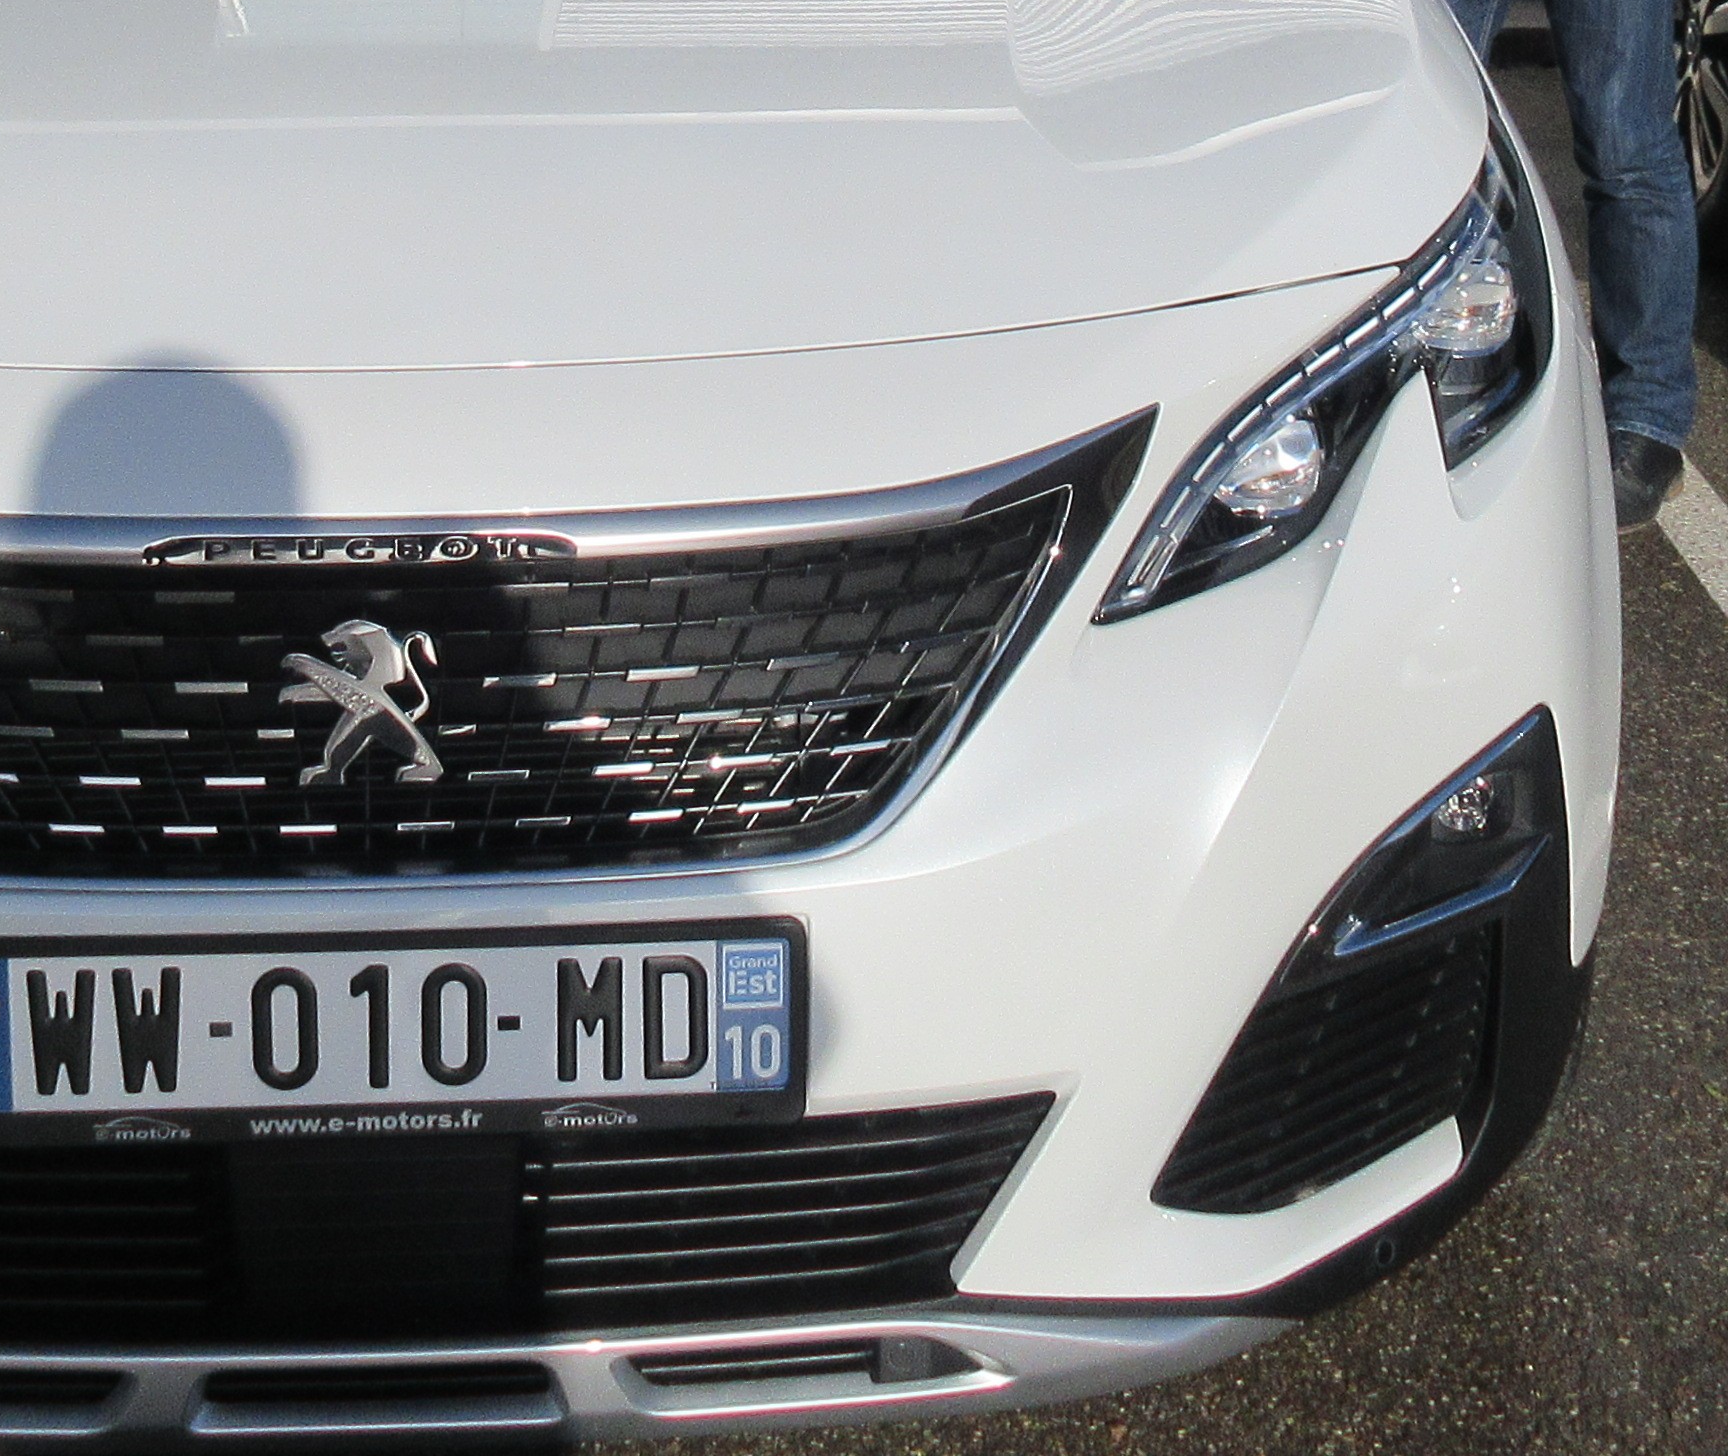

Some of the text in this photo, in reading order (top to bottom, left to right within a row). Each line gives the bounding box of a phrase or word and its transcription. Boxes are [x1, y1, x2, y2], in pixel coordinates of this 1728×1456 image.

[201, 536, 519, 561] PEUGEOT
[729, 955, 778, 968] Grand
[728, 969, 778, 994] Est
[26, 955, 710, 1095] WW-010-MD
[724, 1024, 781, 1079] 10
[250, 1108, 483, 1135] www.e-motors.fr
